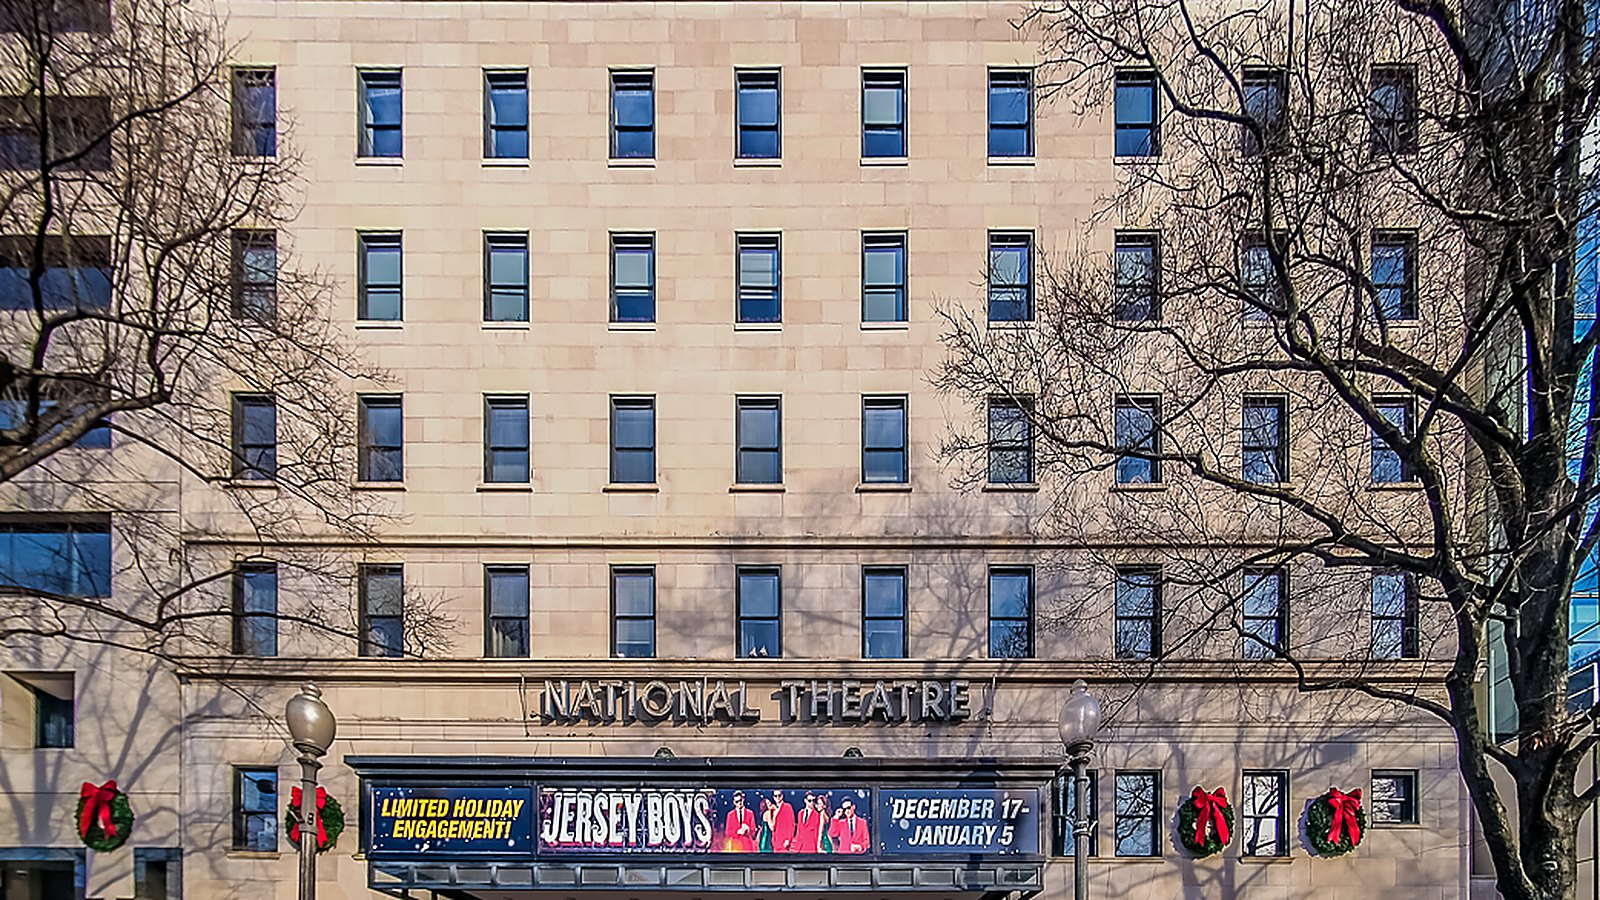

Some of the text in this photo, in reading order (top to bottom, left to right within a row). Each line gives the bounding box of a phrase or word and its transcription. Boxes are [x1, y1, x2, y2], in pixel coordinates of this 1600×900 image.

[544, 680, 971, 722] NATIONAL THEATRE
[380, 798, 525, 819] LIMITED HOLIDAY
[541, 791, 713, 848] JERSEY BOYS
[891, 798, 1030, 820] DECEMBER 17-
[392, 819, 513, 840] ENGAGEMENT!
[908, 825, 1015, 847] JANUARY 5
